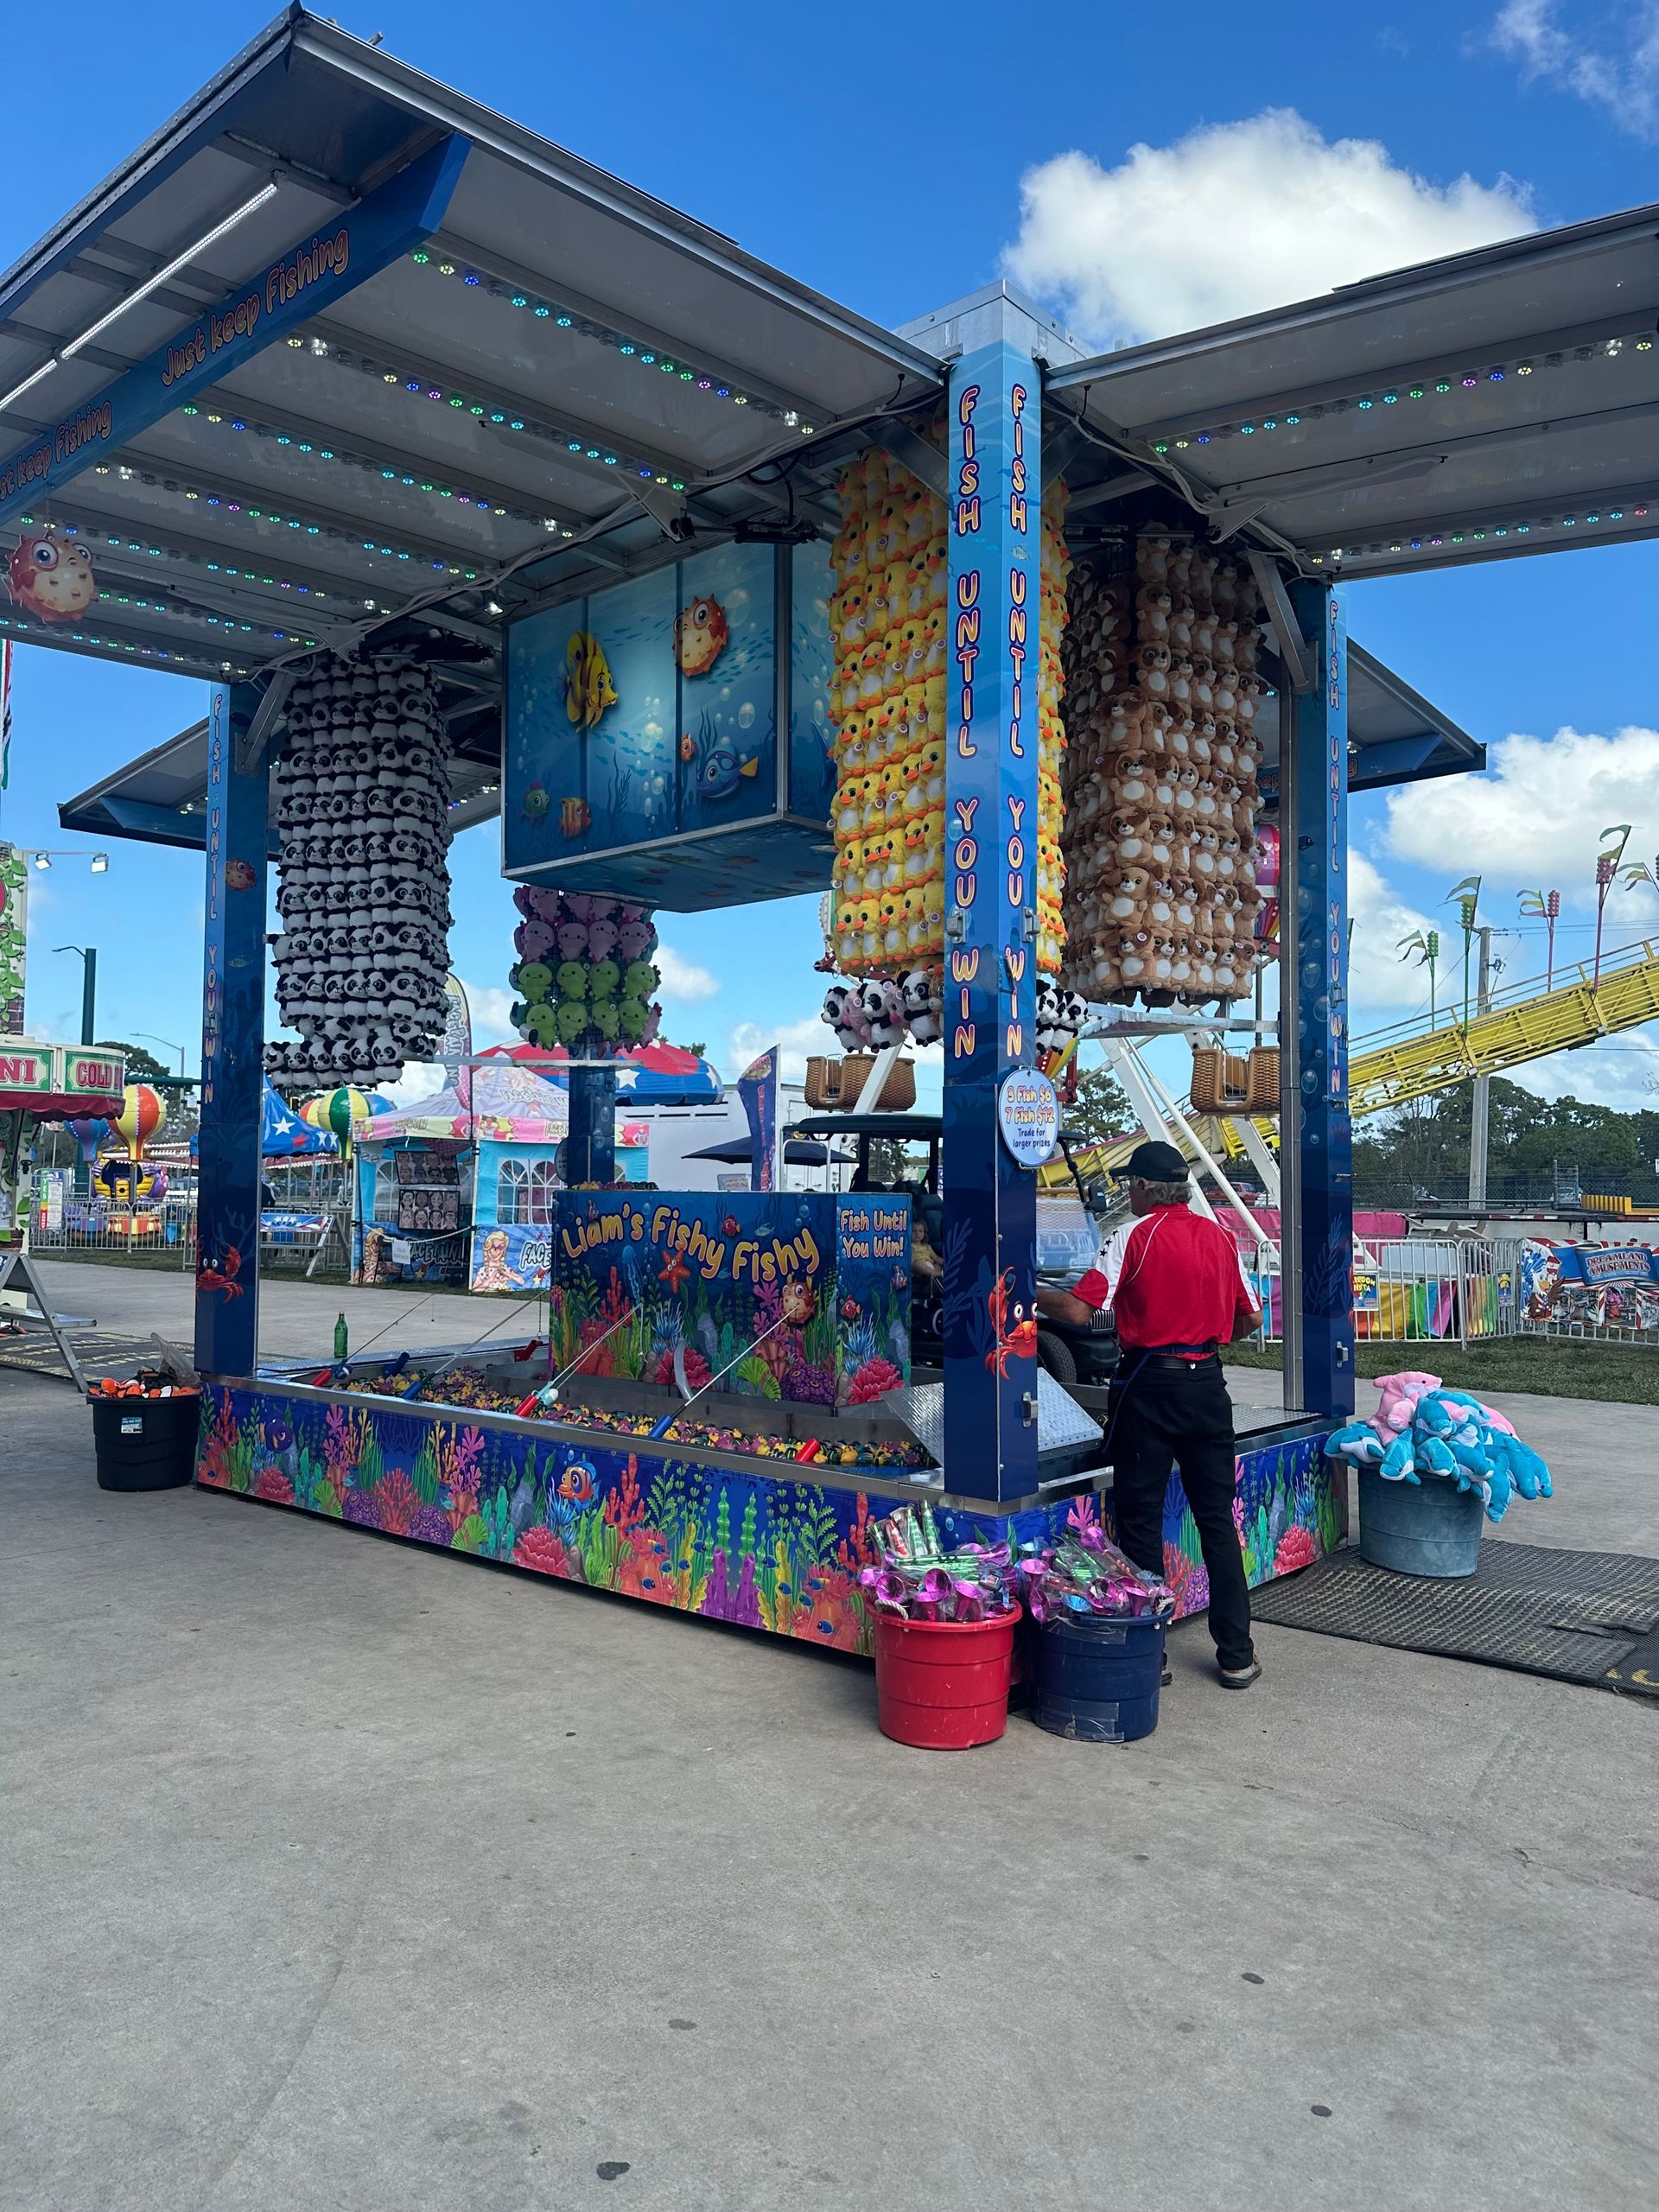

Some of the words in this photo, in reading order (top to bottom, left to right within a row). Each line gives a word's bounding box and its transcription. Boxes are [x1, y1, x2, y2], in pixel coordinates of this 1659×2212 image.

[162, 327, 206, 385] Just
[210, 293, 260, 353] keep
[265, 229, 349, 315] Fishing
[0, 464, 15, 501] st
[17, 442, 52, 489] keep
[55, 400, 112, 464] Fishing
[957, 383, 982, 536] FISH
[1010, 383, 1027, 536] FISH
[955, 567, 981, 759] UNTIL
[1008, 567, 1026, 756] UNTIL
[1329, 600, 1339, 710] FISH
[212, 693, 222, 785] FISH
[1330, 734, 1339, 872] UNTIL
[210, 807, 220, 920] UNTIL
[953, 794, 981, 908] YOU
[1007, 794, 1026, 907] YOU
[207, 944, 218, 1012] YOU
[1330, 899, 1341, 982] YOU
[951, 947, 980, 1059] WIN
[1005, 944, 1026, 1058] WIN
[76, 1060, 112, 1088] COLD
[204, 1037, 216, 1105] WIN
[1007, 1084, 1014, 1103] 3
[1017, 1084, 1037, 1103] Fish
[1039, 1084, 1052, 1105] $6
[1329, 1011, 1342, 1094] WIN
[1005, 1106, 1013, 1124] 7
[1014, 1106, 1035, 1124] Fish
[1037, 1105, 1055, 1126] $12
[1013, 1139, 1032, 1149] larger
[1033, 1139, 1051, 1149] prizes
[1018, 1128, 1035, 1137] Trade
[1036, 1128, 1046, 1136] for
[562, 1203, 645, 1258] Liam's
[651, 1206, 726, 1280] Fishy
[732, 1227, 821, 1283] Fishy
[840, 1209, 870, 1232] Fish
[873, 1209, 907, 1231] Until
[842, 1236, 870, 1259] You
[873, 1236, 904, 1258] Win!
[1586, 1250, 1648, 1268] DREAMLAND
[1587, 1261, 1651, 1277] AMUSEMENTS
